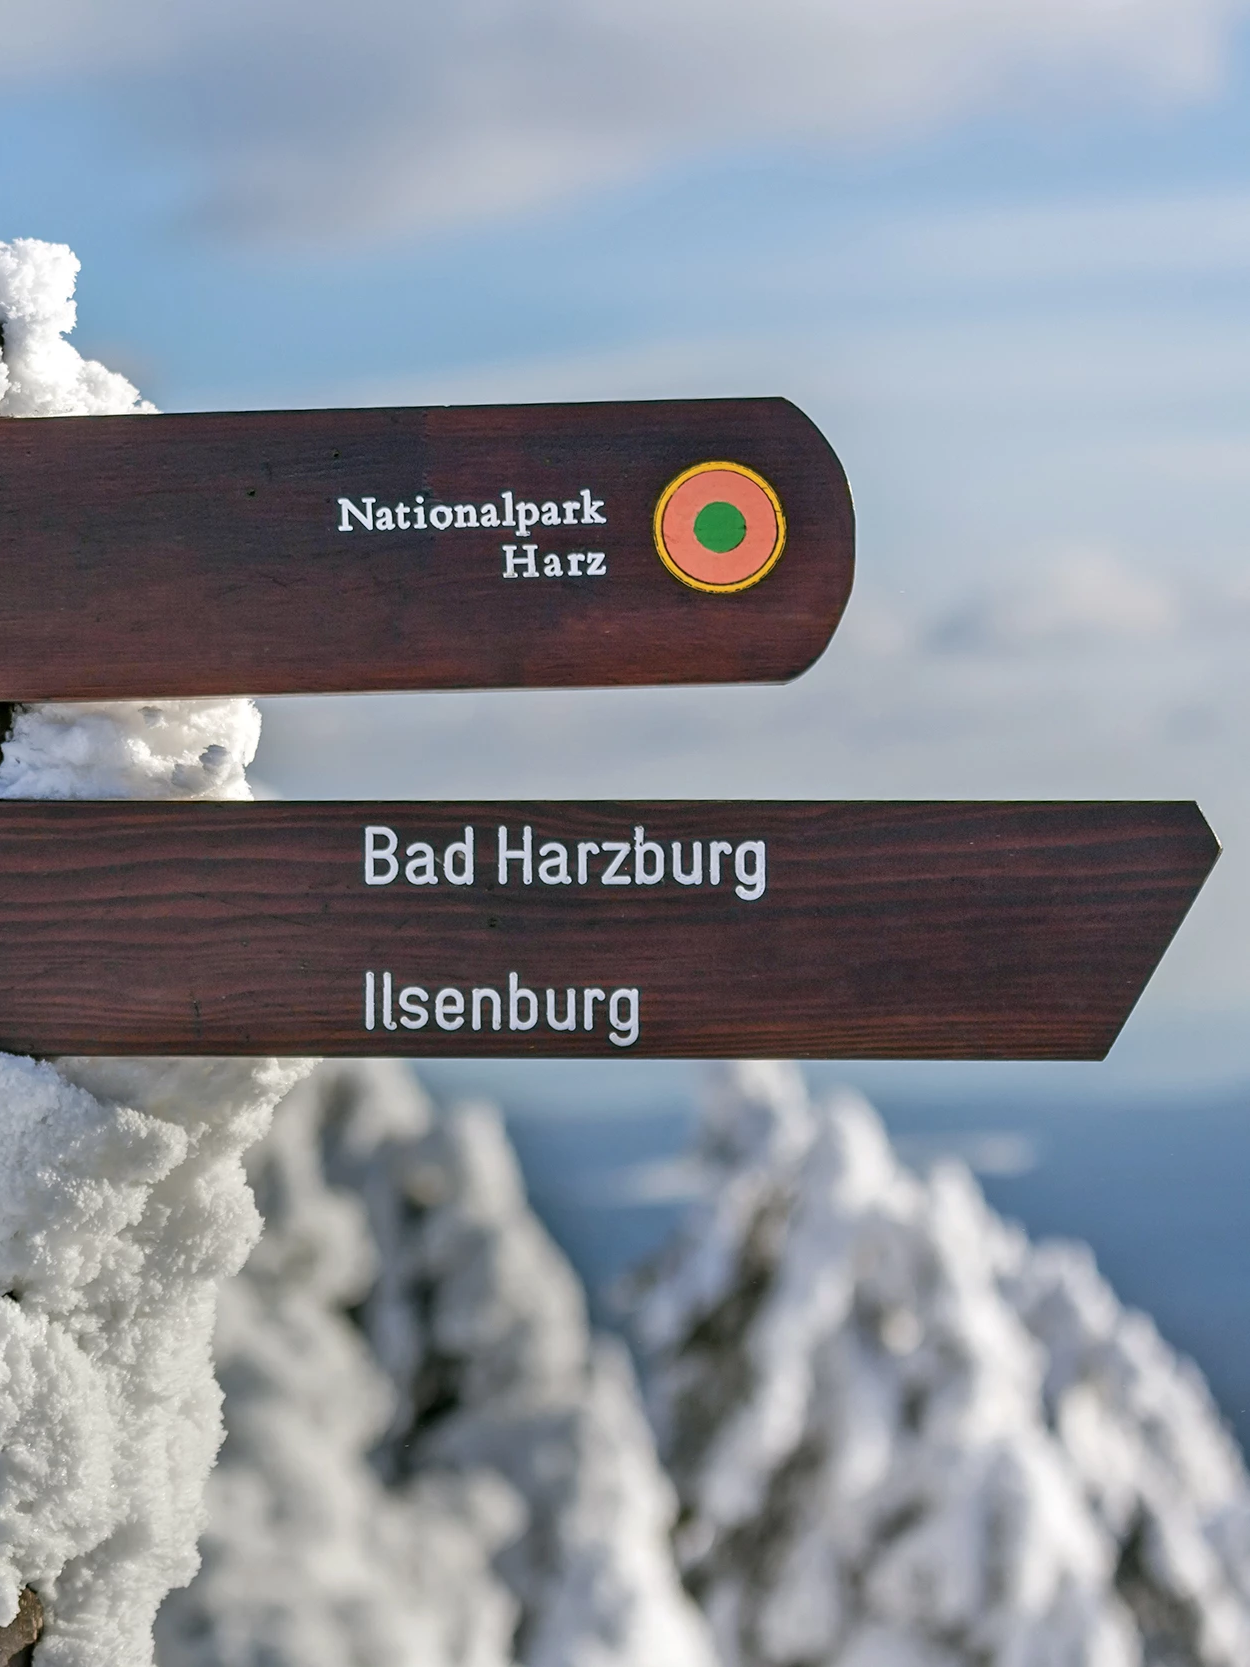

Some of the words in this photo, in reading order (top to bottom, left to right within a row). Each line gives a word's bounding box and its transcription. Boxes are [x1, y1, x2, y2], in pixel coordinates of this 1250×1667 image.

[336, 488, 608, 537] Nationalpark
[501, 544, 608, 579] Harz
[363, 824, 475, 888] Bad
[496, 824, 768, 903] Harzburg
[364, 969, 641, 1048] Ilsenburg
